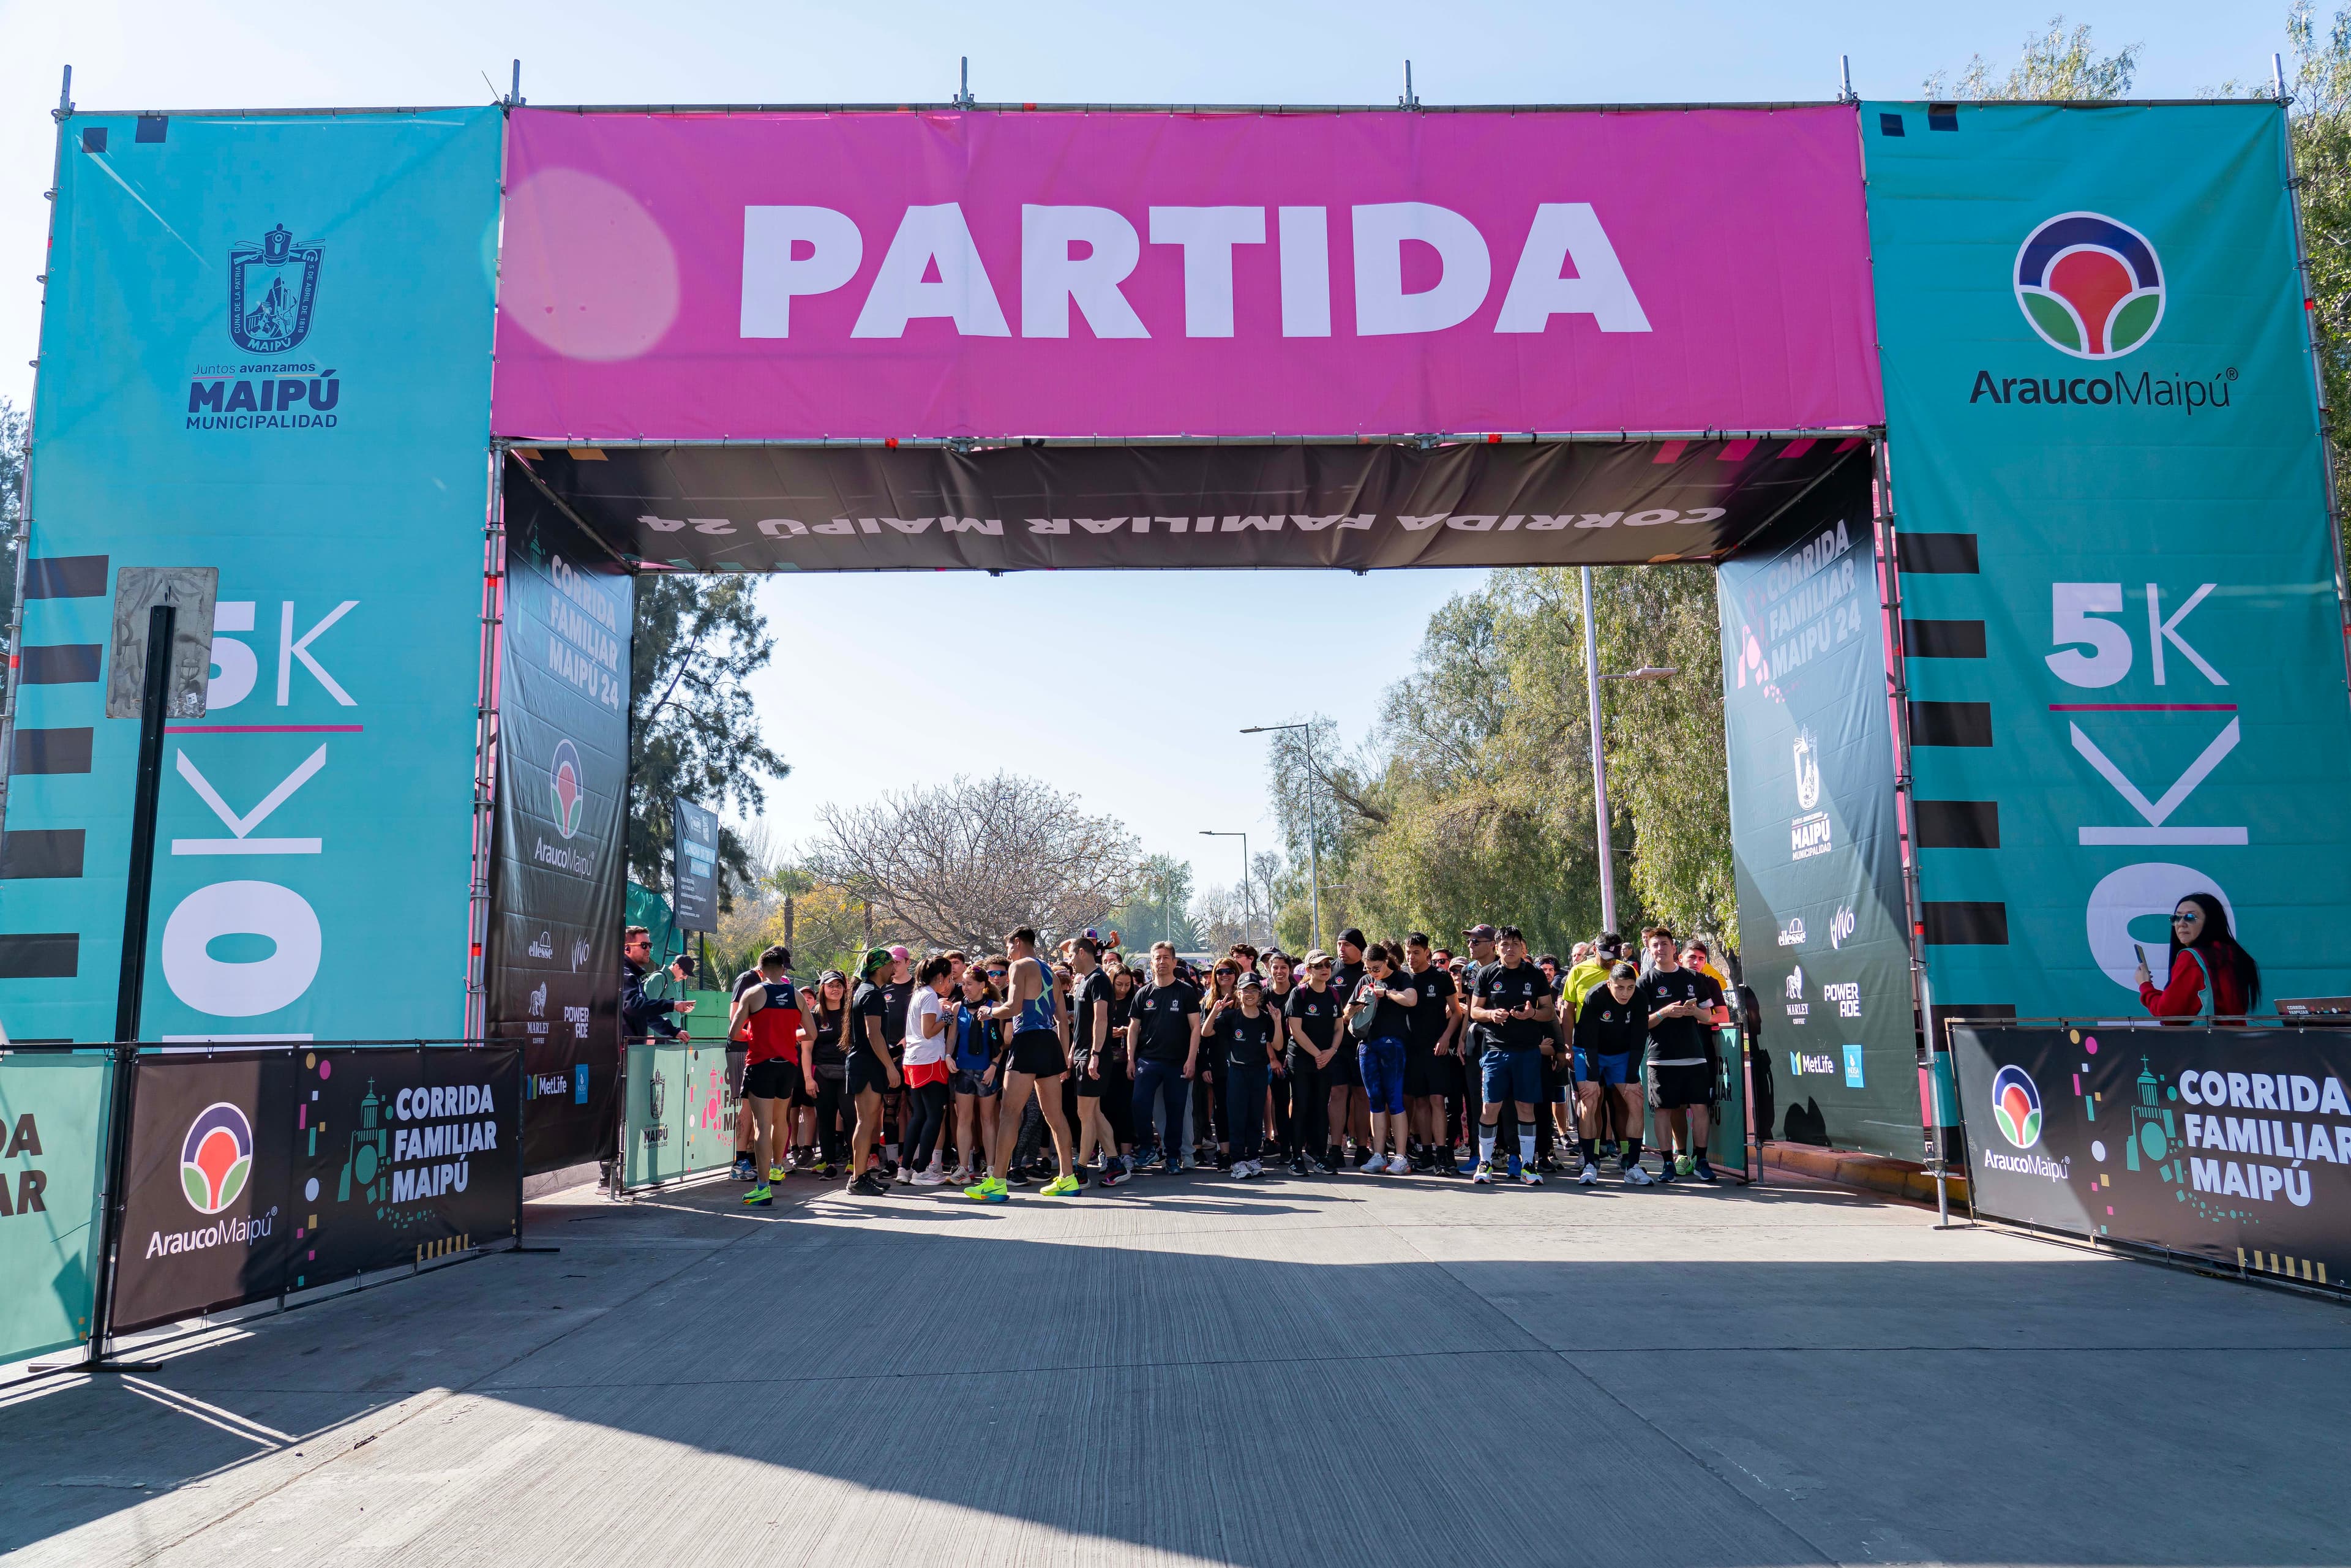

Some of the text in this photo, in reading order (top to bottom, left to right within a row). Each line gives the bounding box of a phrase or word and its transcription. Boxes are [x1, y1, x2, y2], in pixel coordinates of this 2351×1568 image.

[307, 271, 314, 280] DE
[740, 201, 1653, 339] PARTIDA
[234, 291, 241, 301] LA
[304, 283, 312, 304] ABRIL
[234, 303, 241, 313] DE
[301, 306, 308, 315] DE
[247, 337, 291, 351] MAIPÚ
[193, 363, 316, 375] Juntos avanzamos
[188, 369, 340, 413] MAIPÚ
[186, 415, 337, 430] MUNICIPALIDAD
[637, 507, 1727, 538] CORRIDA FAMILIAR MAIPÚ 24
[1767, 519, 1850, 602] CORRIDA
[552, 555, 617, 634] CORRIDA
[1769, 558, 1856, 642] FAMILIAR
[1835, 597, 1861, 644] 24
[551, 594, 618, 673] FAMILIAR
[2044, 583, 2230, 688] 5K
[601, 673, 619, 710] 24
[1791, 813, 1831, 850] MAIPÚ
[1792, 842, 1831, 861] MUNICIPALIDAD
[1778, 930, 1805, 946] ellesse
[528, 941, 553, 959] ellesse
[1824, 983, 1859, 1001] POWER
[564, 1006, 589, 1022] POWER
[1787, 1003, 1809, 1016] MARLEY
[527, 1022, 549, 1034] MARLEY
[576, 1023, 588, 1038] ADE
[1802, 1055, 1834, 1074] MetLife
[539, 1075, 567, 1095] MetLife
[2179, 1070, 2351, 1116] CORRIDA
[396, 1084, 495, 1121] CORRIDA
[394, 1121, 497, 1162] FAMILIAR
[643, 1124, 668, 1143] MAIPÚ
[2184, 1113, 2351, 1165] FAMILIAR
[392, 1153, 468, 1204] MAIPÚ
[2190, 1157, 2311, 1207] MAIPÚ
